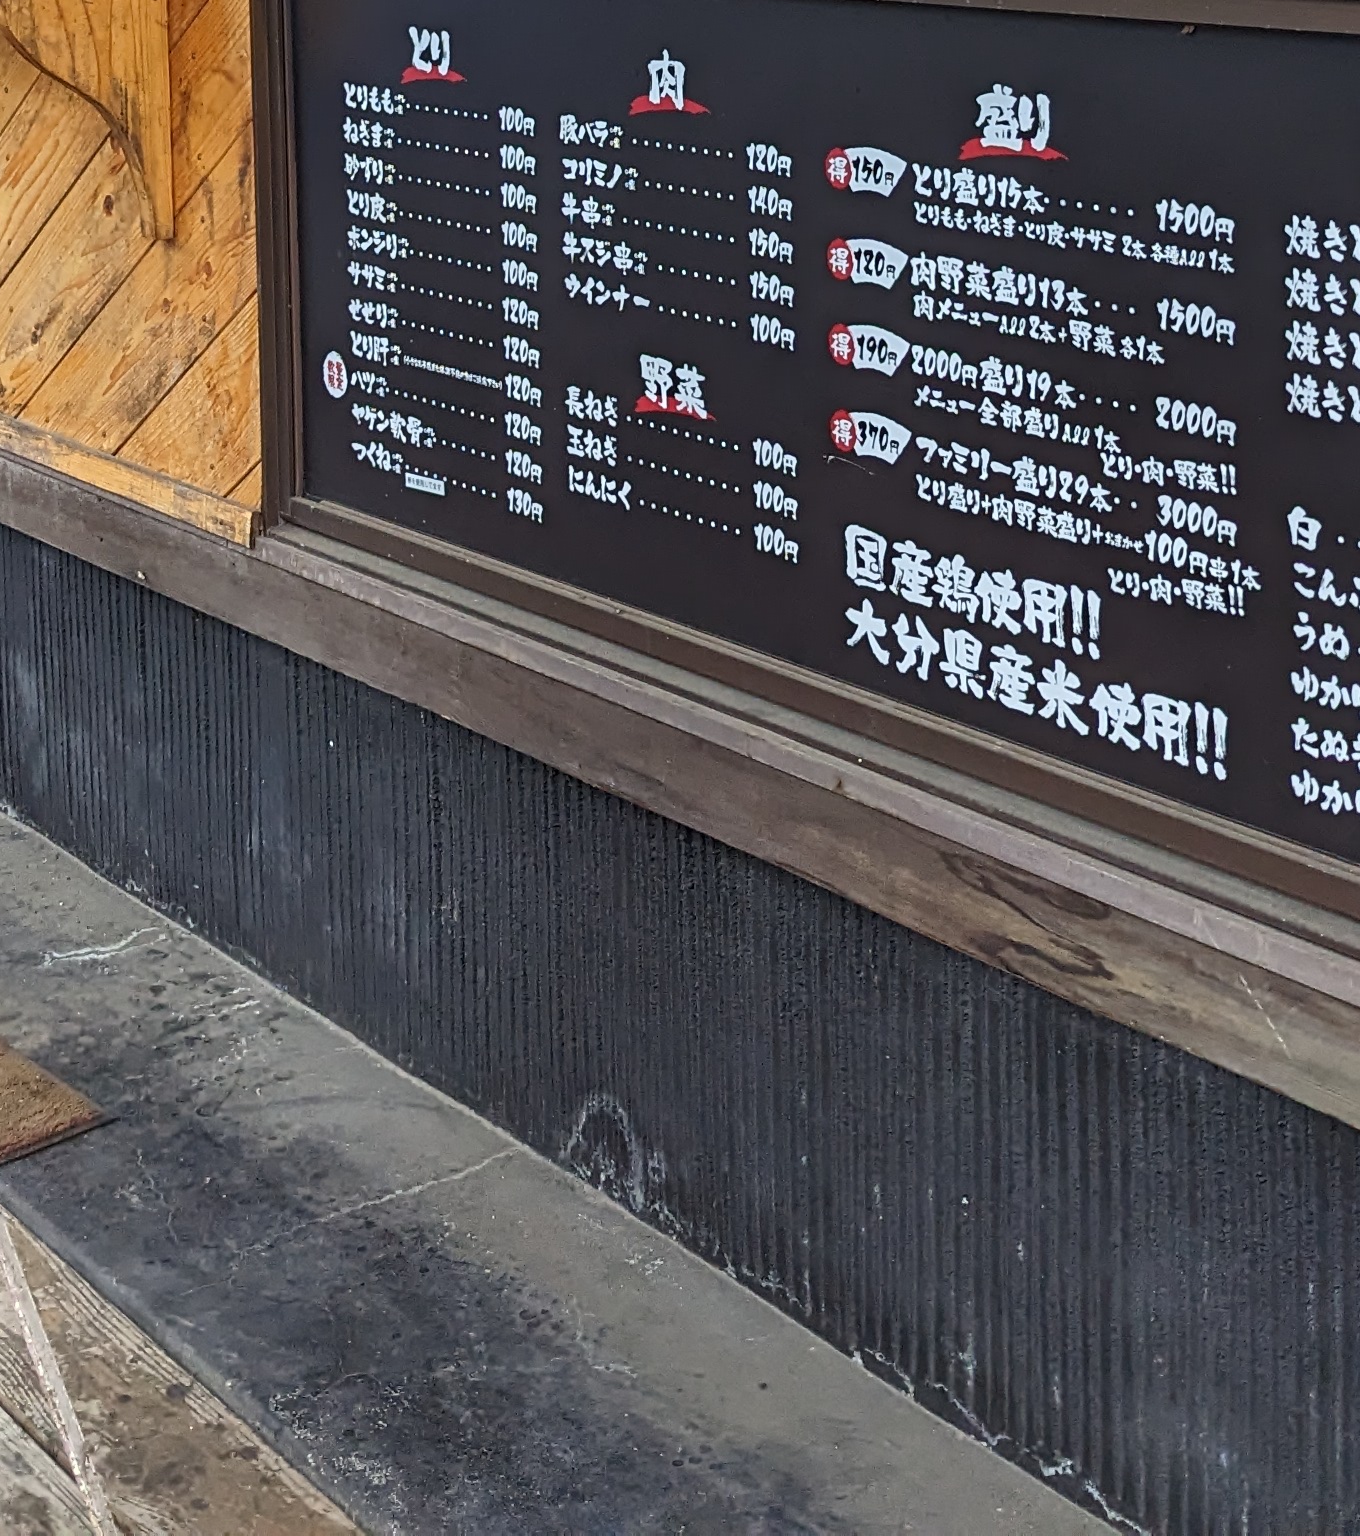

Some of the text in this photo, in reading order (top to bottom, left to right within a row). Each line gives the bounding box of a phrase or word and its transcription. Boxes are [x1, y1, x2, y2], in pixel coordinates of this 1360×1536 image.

[409, 26, 450, 76] とり
[648, 49, 685, 110] 肉
[344, 82, 394, 114] とりもも
[499, 106, 535, 137] 100円
[975, 83, 1050, 152] 盛り
[343, 117, 383, 148] ねぎま
[500, 145, 536, 175] 100円
[559, 114, 791, 177] 豚バラ 120円
[852, 155, 894, 186] 150円
[347, 189, 386, 224] とり皮
[501, 221, 538, 253] 100円
[500, 182, 537, 214] 100円
[561, 192, 793, 264] 牛串 150円
[748, 185, 792, 221] 140円
[912, 163, 1236, 244] とり盛り15本 1500円
[347, 261, 386, 291] ササミ
[502, 297, 539, 330] 120円
[502, 259, 539, 292] 100円
[562, 231, 794, 307] 牛スジ串 150円
[853, 246, 896, 279] 120円
[564, 273, 795, 351] ウインナー 100円
[910, 252, 1236, 345] 肉野菜盛り13本 1500円
[348, 299, 387, 328] せせり
[503, 335, 540, 369] 120円
[857, 334, 897, 366] 190円
[350, 331, 389, 366] とり肝
[504, 373, 542, 407] 120円
[639, 354, 708, 419] 野菜
[911, 344, 1237, 446] 2000円盛り19本 2000円
[350, 370, 376, 394] ハツ
[504, 411, 542, 446] 120円
[565, 386, 798, 477] 長ねぎ 100円
[857, 422, 900, 455] 370円
[351, 403, 424, 447] ヤゲン軟骨
[505, 449, 542, 484] 120円
[566, 424, 798, 520] 玉ねぎ 100円
[351, 441, 391, 471] つくね
[506, 487, 543, 523] 130円
[568, 465, 799, 564] にんにく 100円
[915, 436, 1238, 547] ファミリー盛り29本 3000円
[1286, 505, 1322, 552] 白
[845, 524, 1101, 660] 国産鶏使用!!
[1292, 612, 1350, 661] うめ
[845, 598, 1228, 781] 大分県産米使用!!
